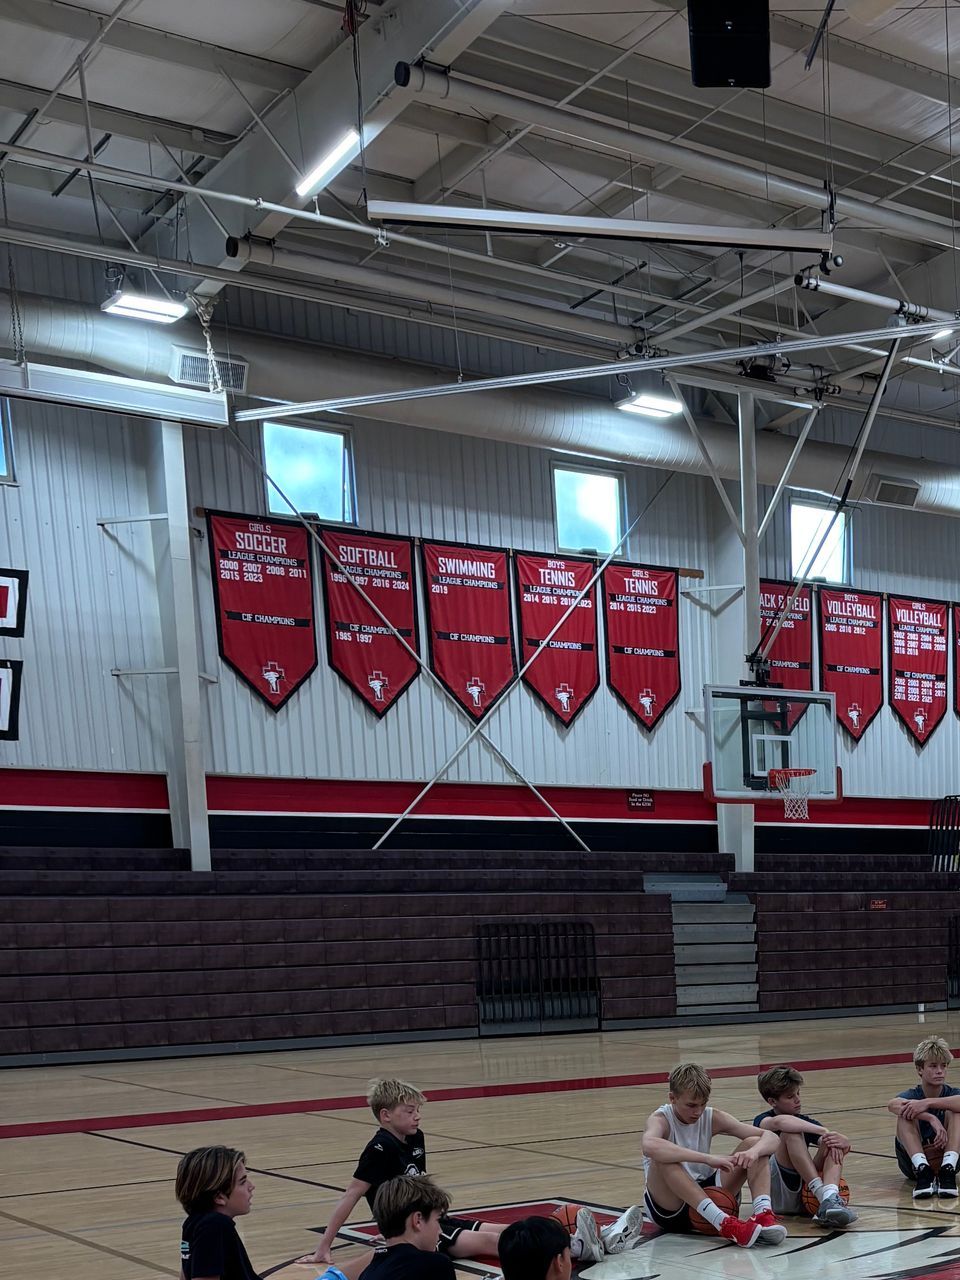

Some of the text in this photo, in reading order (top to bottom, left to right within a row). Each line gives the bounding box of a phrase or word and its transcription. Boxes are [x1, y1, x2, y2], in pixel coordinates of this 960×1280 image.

[248, 523, 271, 533] GIRLS
[235, 532, 287, 554] SOCCER
[228, 551, 297, 566] LEAGUE CHAMPIONS
[338, 545, 398, 568] SOFTBALL
[220, 560, 307, 578] 2000 2007 2008 2011
[438, 557, 495, 578] SWIMMING
[547, 560, 565, 569] BOYS
[220, 570, 263, 582] 2015 2023
[538, 568, 575, 587] TENNIS
[439, 576, 498, 589] LEAGUE CHAMPIONS
[624, 578, 658, 595] TENNIS
[615, 594, 667, 606] LEAGUE CHAMPIONS
[827, 600, 876, 619] VOLLEYBALL
[241, 613, 295, 625] CIF CHAMPIONS
[896, 608, 942, 626] VOLLEYBALL
[335, 631, 352, 641] 1985
[460, 634, 495, 643] CHAMPIONS
[549, 641, 582, 650] CHAMPIONS
[633, 648, 664, 657] CHAMPIONS
[772, 660, 799, 669] CHAMPIONS
